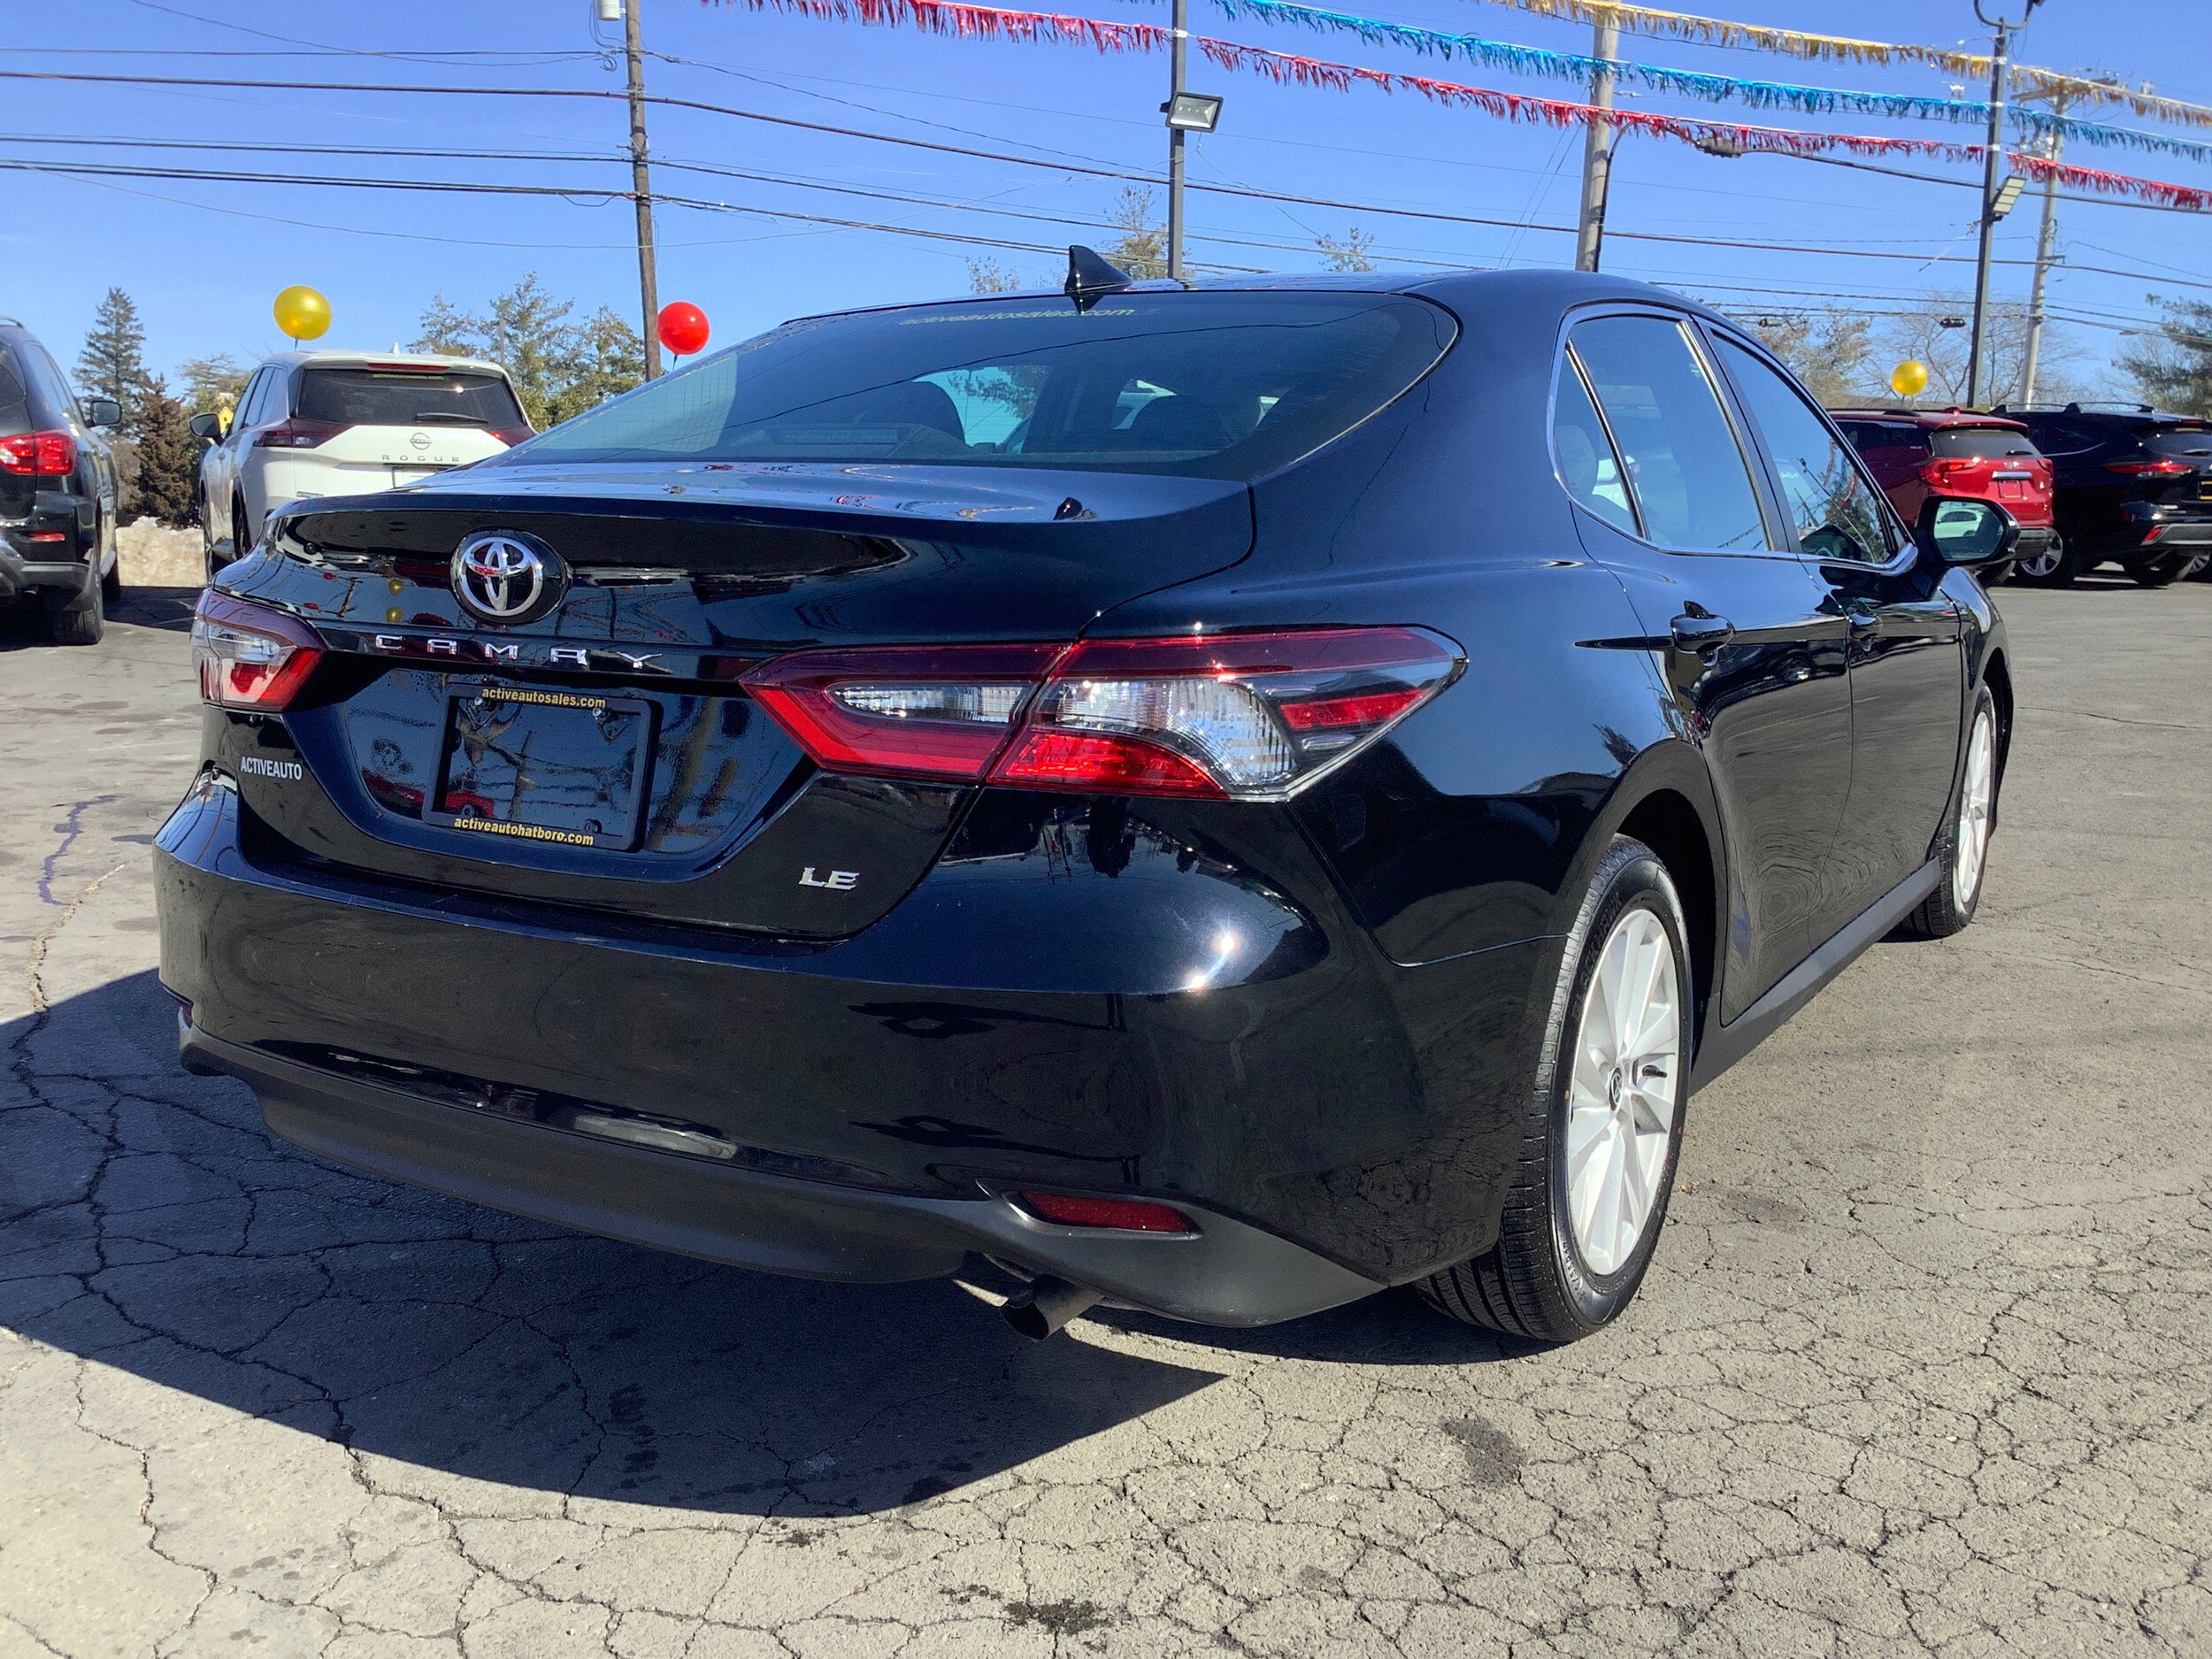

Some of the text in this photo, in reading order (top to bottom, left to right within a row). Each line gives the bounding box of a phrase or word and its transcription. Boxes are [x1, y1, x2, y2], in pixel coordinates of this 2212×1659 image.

[375, 634, 663, 668] CAMRY
[481, 687, 606, 709] activeautosales.com
[240, 756, 303, 780] ACTIVEAUTO
[454, 816, 594, 846] activeautohatboro.com
[798, 867, 860, 890] LE
